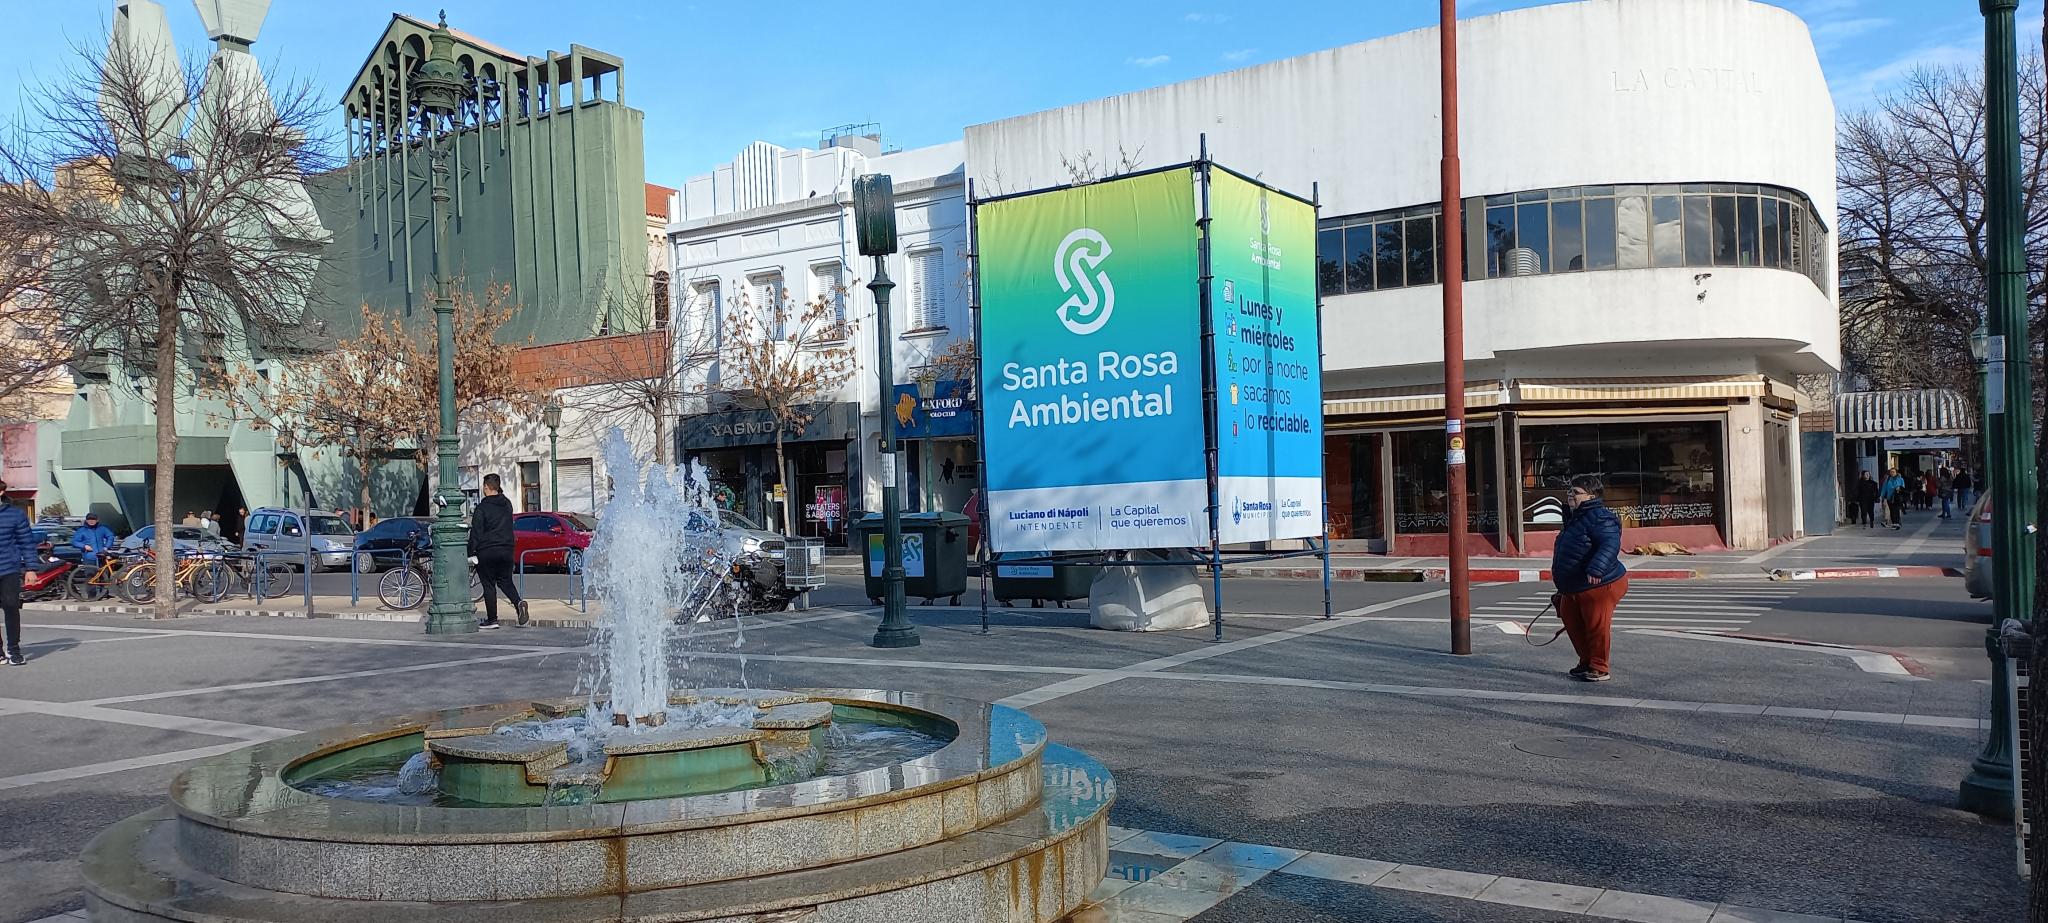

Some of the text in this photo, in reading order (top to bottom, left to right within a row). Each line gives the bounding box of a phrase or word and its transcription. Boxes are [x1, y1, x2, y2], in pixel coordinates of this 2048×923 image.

[1611, 68, 1648, 92] LA
[1249, 237, 1282, 256] Santa Rosa
[1239, 294, 1283, 326] Lunes y
[1241, 324, 1295, 352] miércoles
[1002, 351, 1178, 391] Santa Rosa
[1242, 354, 1308, 381] por la noche
[922, 398, 963, 410] XFORD
[1243, 384, 1291, 406] sacamos
[1008, 384, 1173, 429] Ambiental
[1244, 407, 1312, 434] lo reciclable.
[805, 502, 840, 511] SWEATERS
[1009, 506, 1089, 520] Luciano di Nápoli
[1110, 504, 1160, 518] La Capital
[1242, 501, 1272, 511] Santa Rosa
[1242, 511, 1272, 519] MUNICIPIO
[1016, 521, 1083, 531] INTENDENTE
[1110, 516, 1187, 529] que queremos
